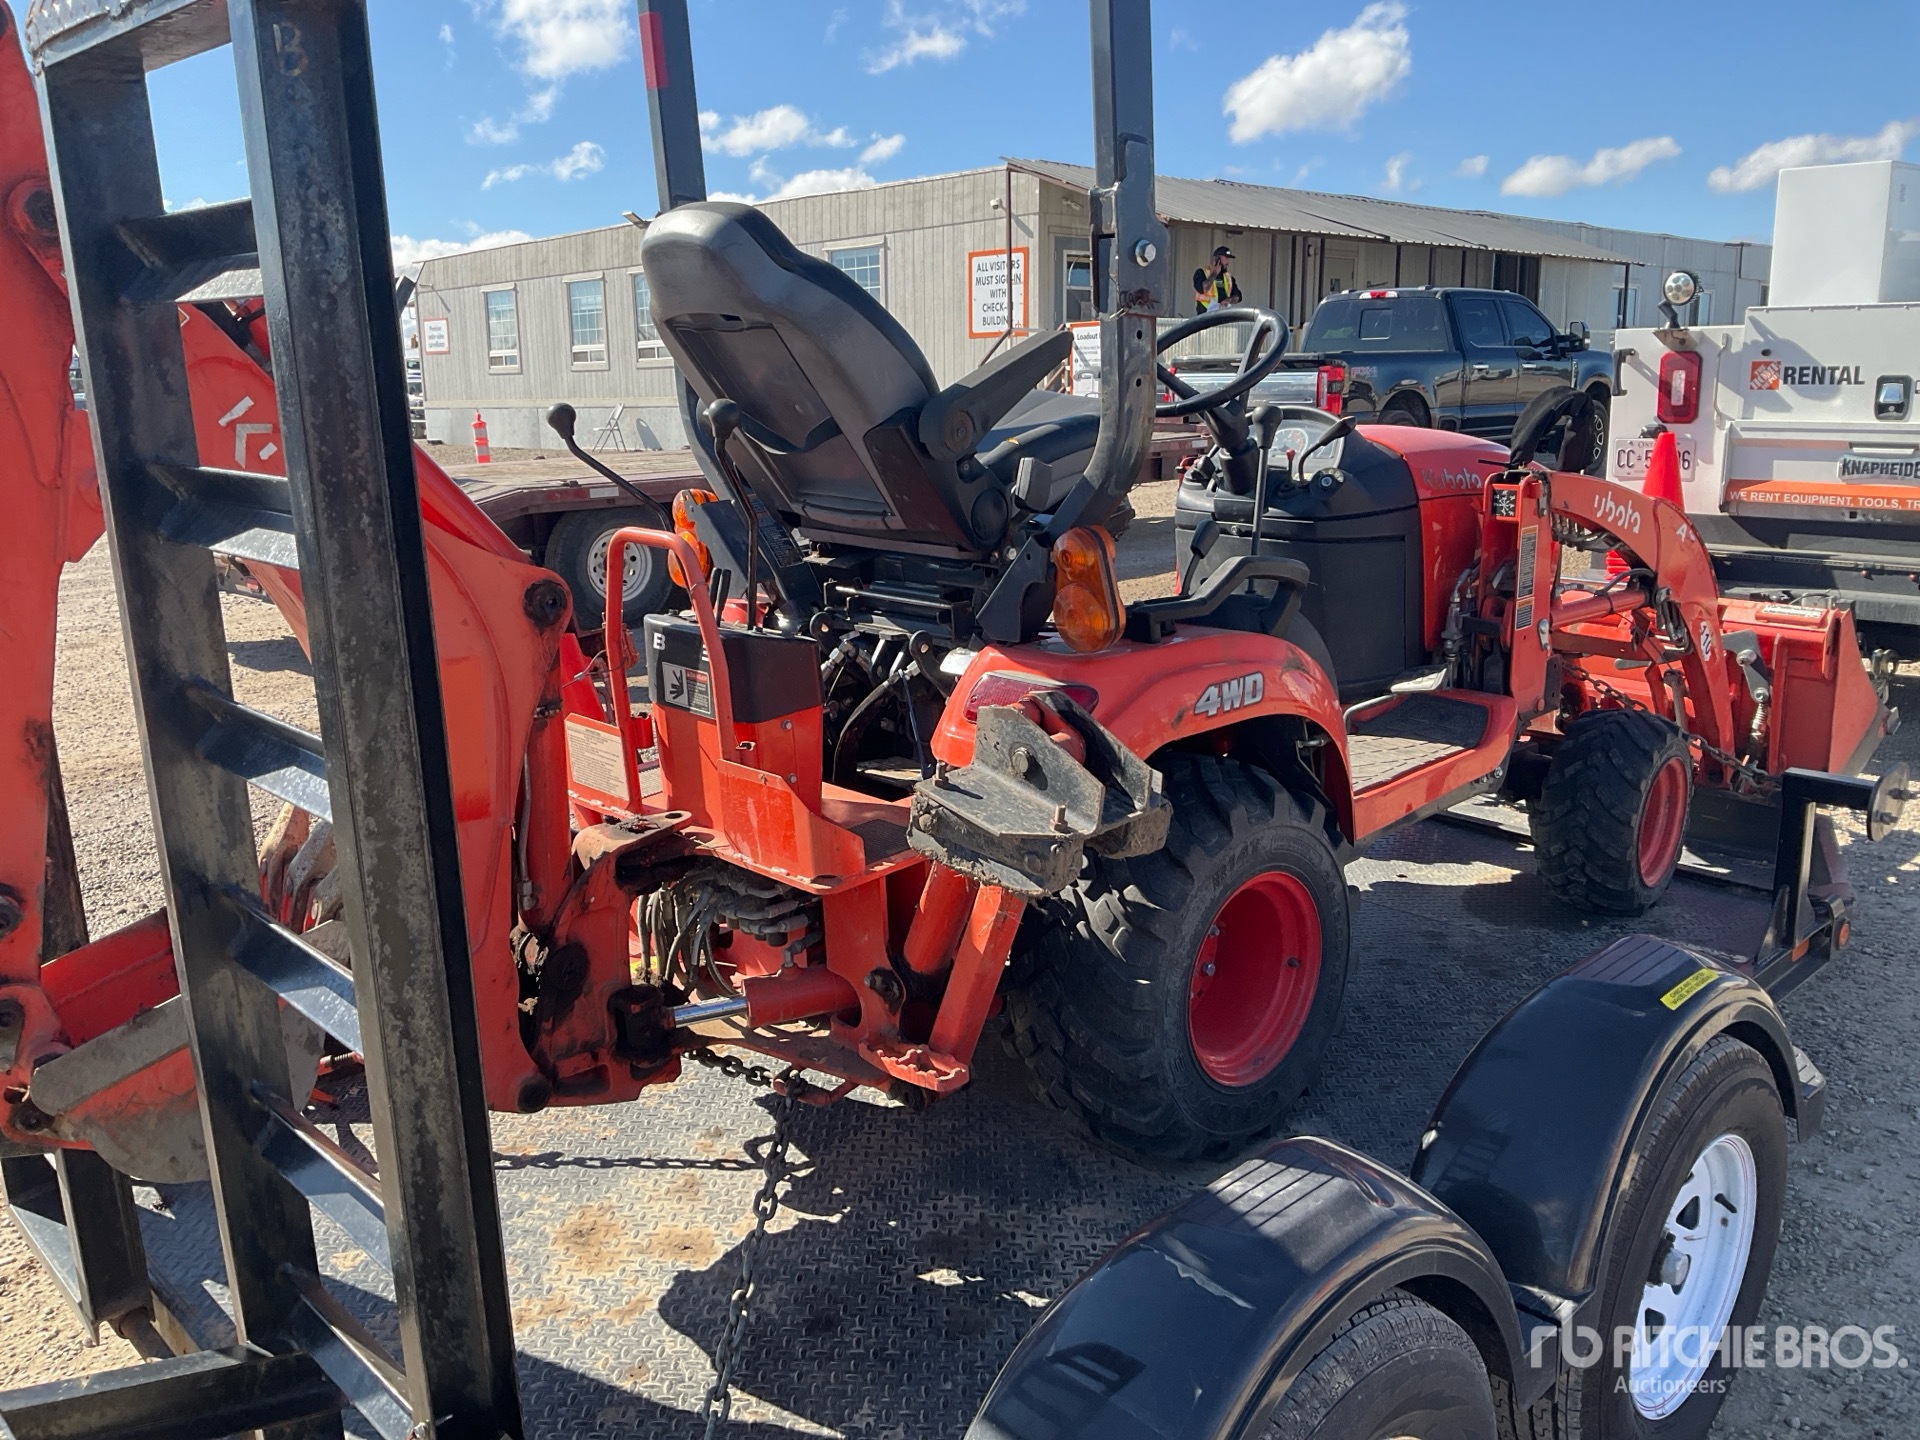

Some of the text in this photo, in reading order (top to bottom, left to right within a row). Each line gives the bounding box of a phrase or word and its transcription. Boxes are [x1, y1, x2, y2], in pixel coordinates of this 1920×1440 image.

[977, 259, 1020, 272] ALL VISITRS
[976, 273, 1021, 286] MUST SIG-IN
[990, 289, 1006, 298] WITH
[982, 315, 1009, 326] BUILDIN
[1782, 365, 1866, 385] RENTAL
[1730, 491, 1747, 501] WE
[1750, 492, 1780, 502] RENT
[1194, 671, 1265, 718] 4WD
